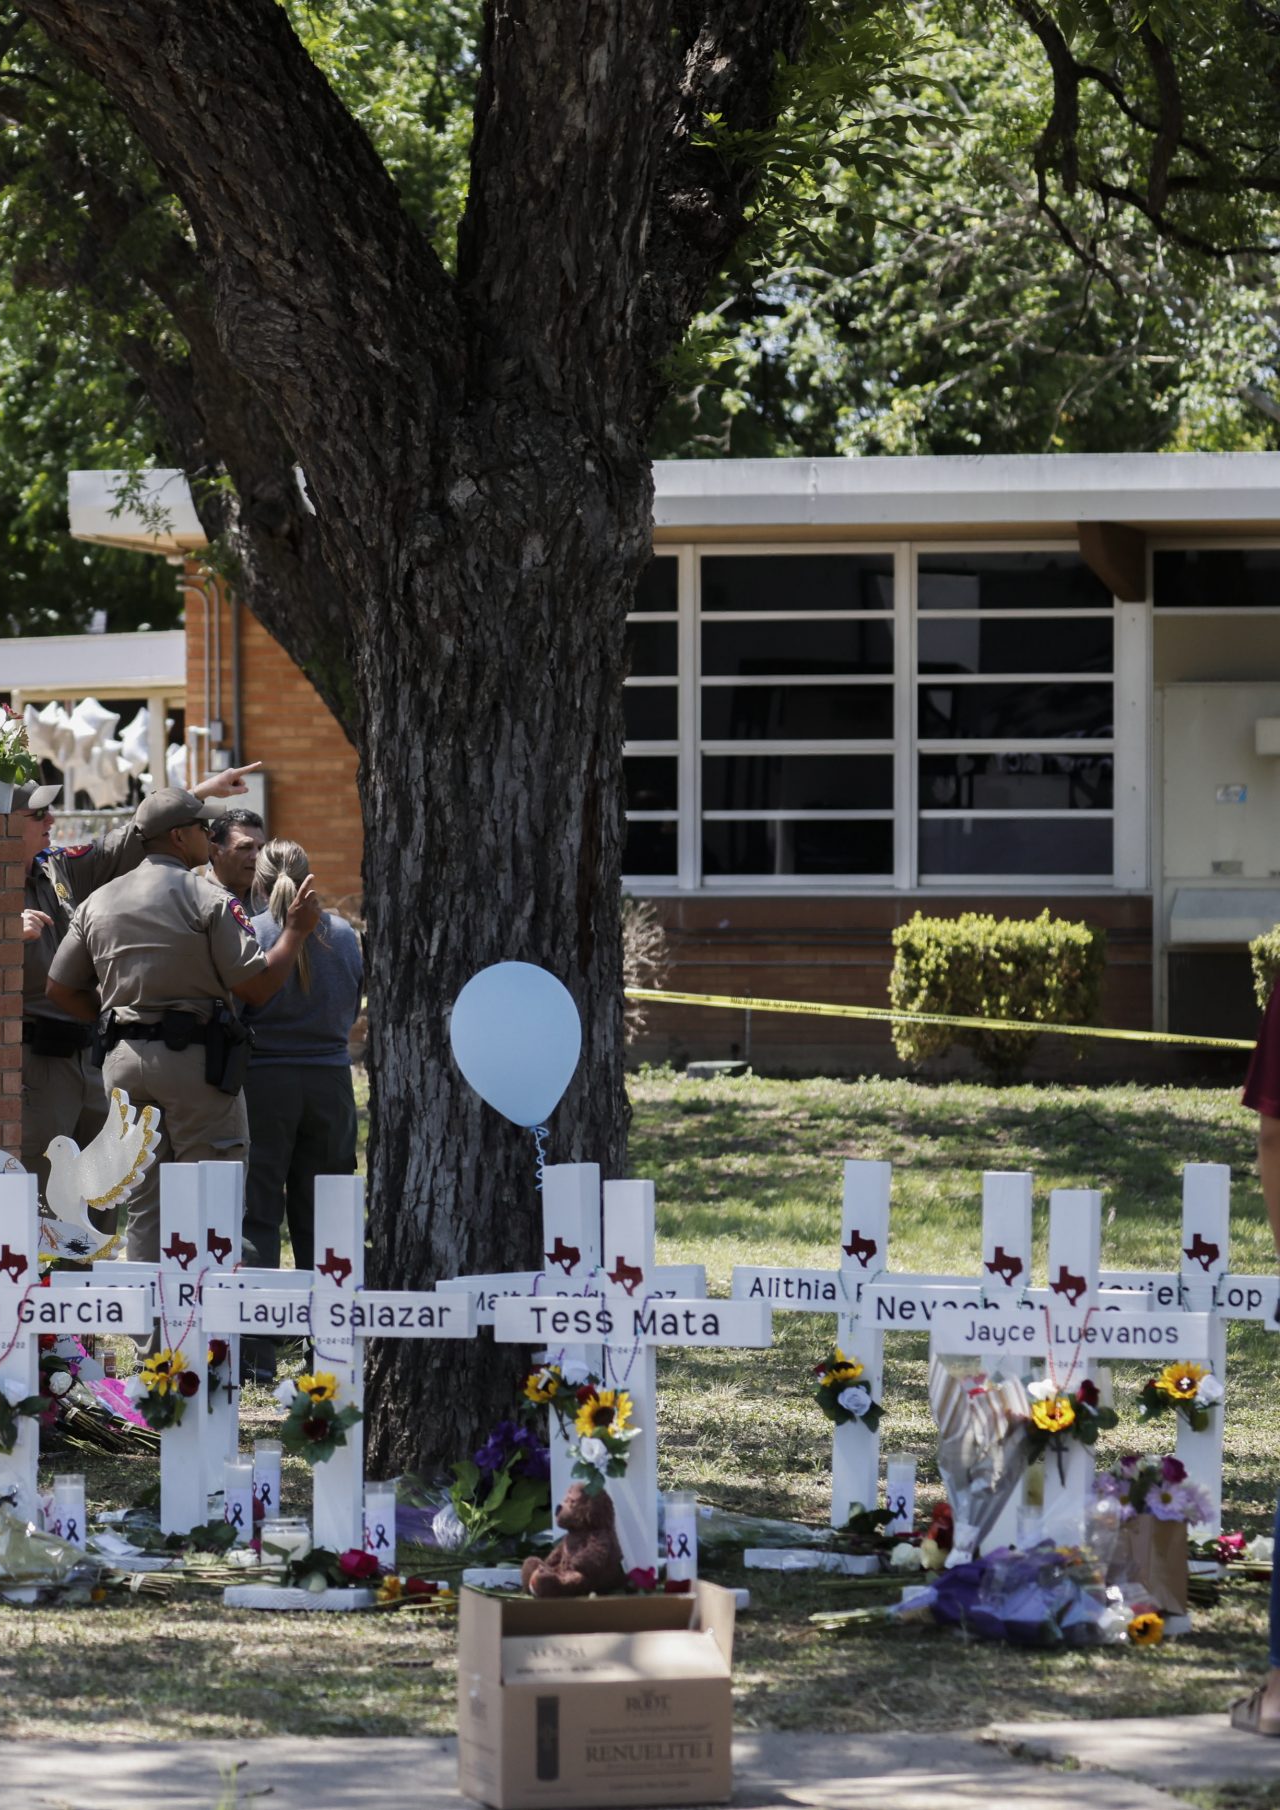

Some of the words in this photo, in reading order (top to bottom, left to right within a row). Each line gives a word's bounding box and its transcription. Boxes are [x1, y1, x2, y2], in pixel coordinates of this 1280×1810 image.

[749, 1277, 837, 1300] Alithia
[17, 1298, 124, 1323] Garcia
[239, 1301, 311, 1329] Layla
[330, 1302, 452, 1328] Salazar
[530, 1307, 614, 1334] Tess
[633, 1309, 721, 1336] Mata
[965, 1320, 1036, 1346] Jayce
[1054, 1323, 1179, 1344] Luevanos
